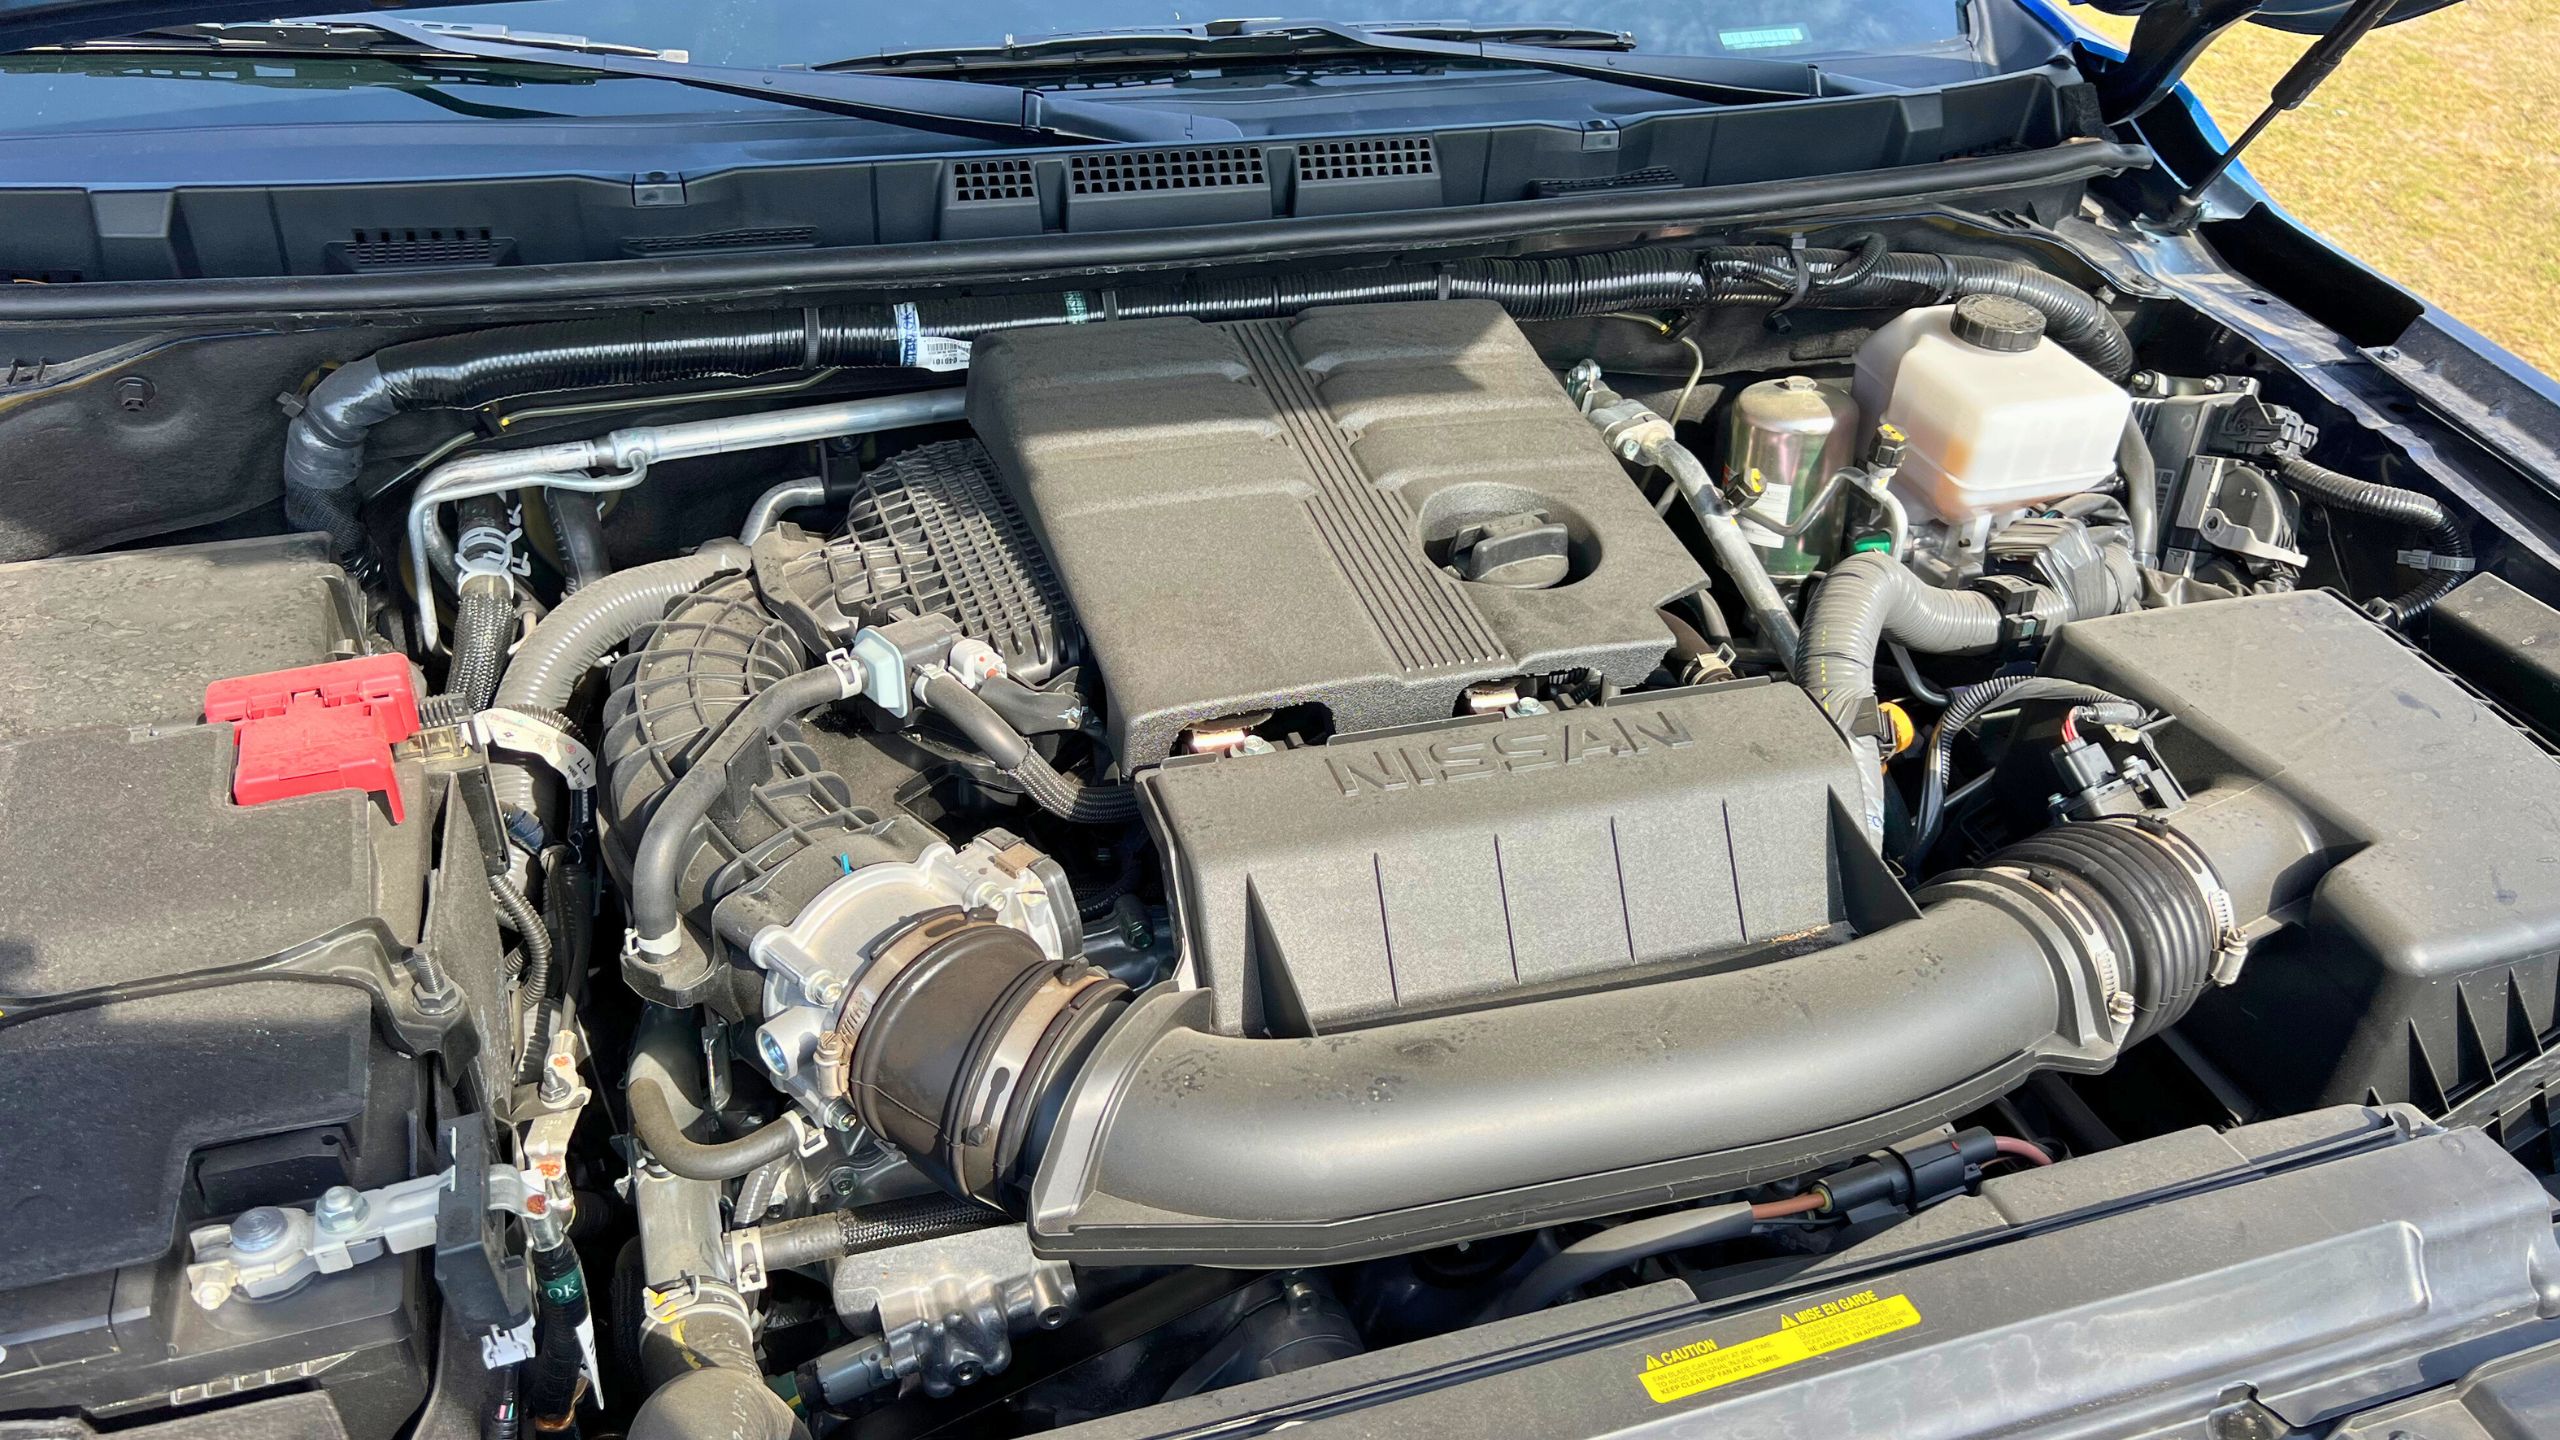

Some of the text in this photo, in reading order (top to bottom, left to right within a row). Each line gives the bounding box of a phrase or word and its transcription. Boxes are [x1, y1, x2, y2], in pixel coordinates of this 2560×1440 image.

[1324, 711, 1694, 797] NISSAN
[547, 1280, 578, 1300] OK
[1794, 1290, 1878, 1323] MISE EN GARDE
[1846, 1317, 1862, 1325] TOUT
[1819, 1337, 1842, 1348] JAMAIS
[1863, 1319, 1904, 1335] APPROCHER
[1652, 1374, 1666, 1382] FAN
[1666, 1366, 1691, 1377] BLADE
[1691, 1361, 1706, 1370] CAN
[1708, 1354, 1729, 1364] START
[1740, 1347, 1753, 1355] ANY
[1660, 1339, 1717, 1364] CAUTION
[1660, 1384, 1679, 1394] KEEP
[1681, 1377, 1705, 1388] CLEAR
[1717, 1368, 1732, 1377] FAN
[1743, 1360, 1756, 1369] ALL
[1668, 1374, 1689, 1384] AVOID
[1689, 1362, 1726, 1378] PERSONAL
